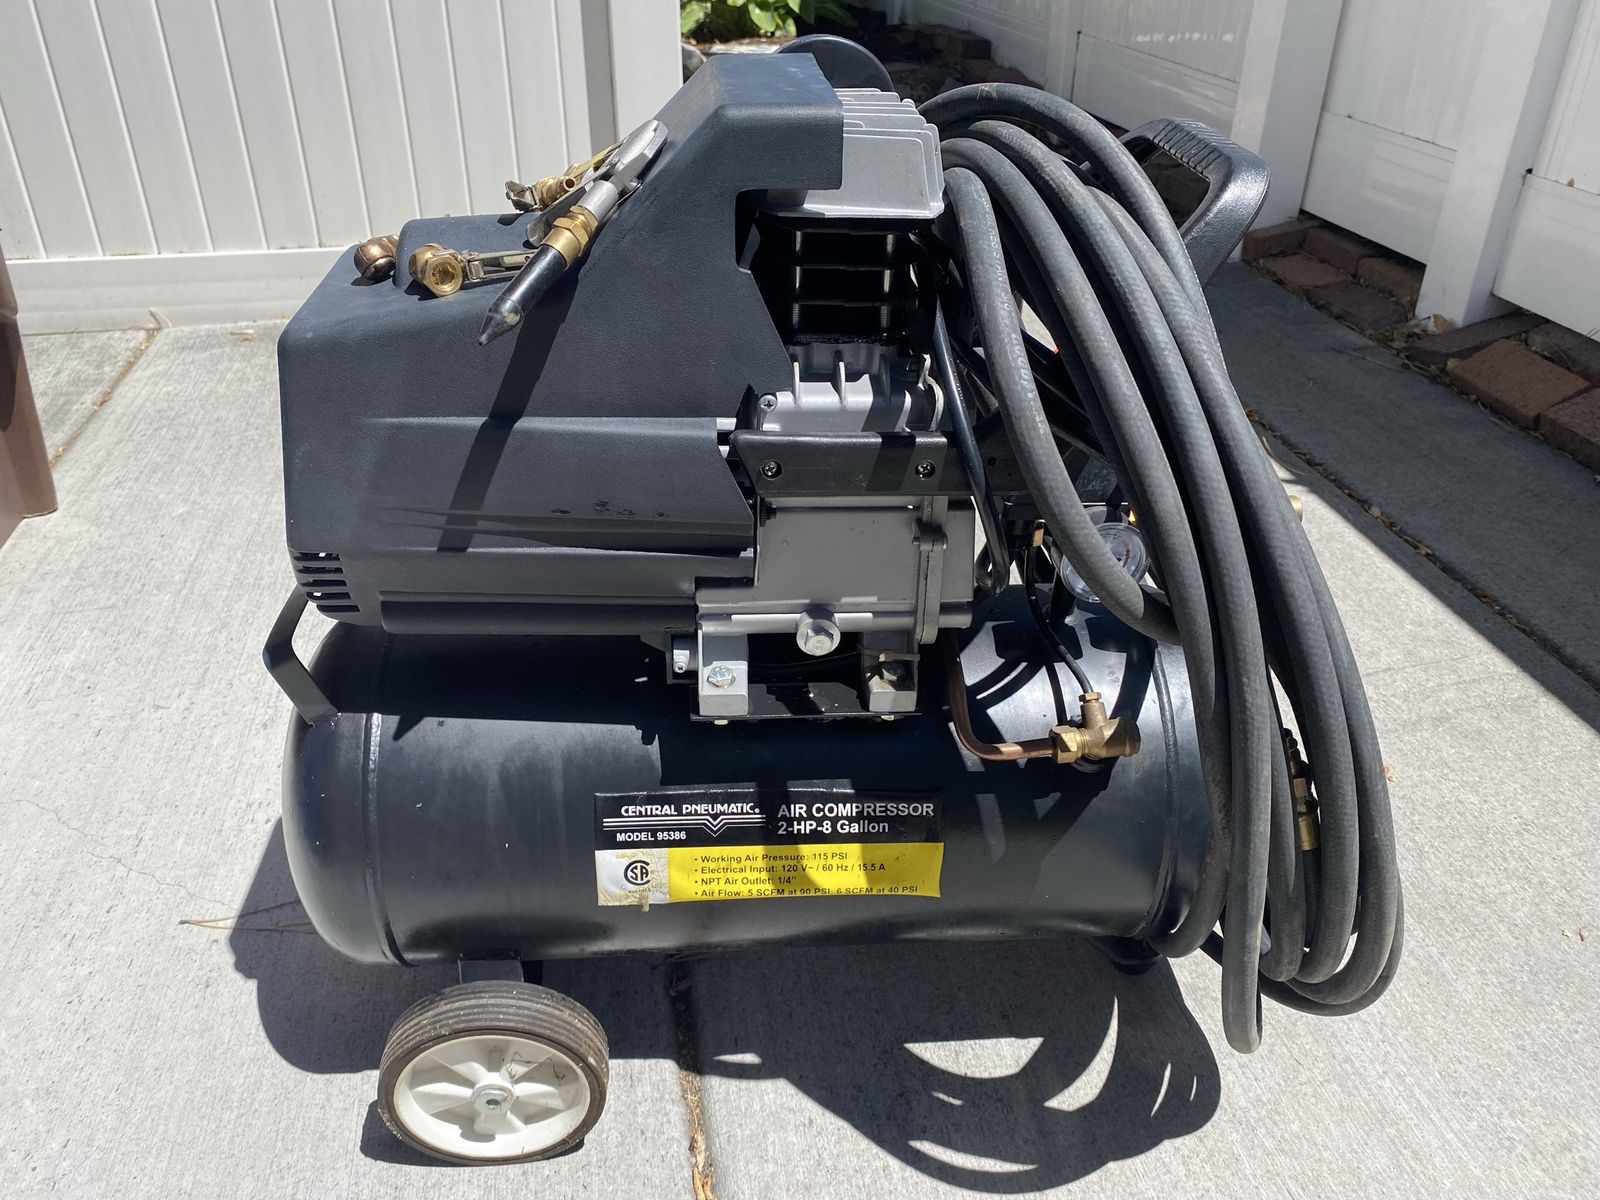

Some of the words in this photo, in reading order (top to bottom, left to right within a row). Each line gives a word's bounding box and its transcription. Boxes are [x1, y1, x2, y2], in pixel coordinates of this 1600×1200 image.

[621, 804, 678, 817] CENTRAL
[777, 804, 808, 818] AIR
[812, 803, 934, 818] COMPRESSOR
[777, 821, 832, 835] 2-HP-8
[836, 820, 889, 834] Gallon
[616, 832, 655, 842] MODEL
[656, 831, 687, 841] 95386
[700, 854, 742, 864] Working
[744, 854, 759, 862] Air
[761, 853, 809, 862] Pressure:
[812, 852, 829, 861] 115
[831, 852, 848, 860] PSI
[701, 865, 747, 874] Electrical
[749, 865, 779, 875] Input:
[782, 864, 798, 873] 120
[822, 864, 834, 872] 60
[836, 863, 849, 872] Hz
[857, 863, 876, 872] 15.5
[878, 863, 886, 871] A
[701, 877, 722, 886] NPT
[723, 877, 739, 886] Air
[741, 877, 775, 886] Outlet:
[700, 889, 715, 897] Air
[718, 889, 745, 897] Flow:
[747, 889, 754, 897] 5
[756, 888, 785, 897] SCFM
[836, 887, 843, 895] 6
[844, 887, 874, 895] SCFM
[887, 886, 900, 894] 40
[901, 885, 918, 894] PSI
